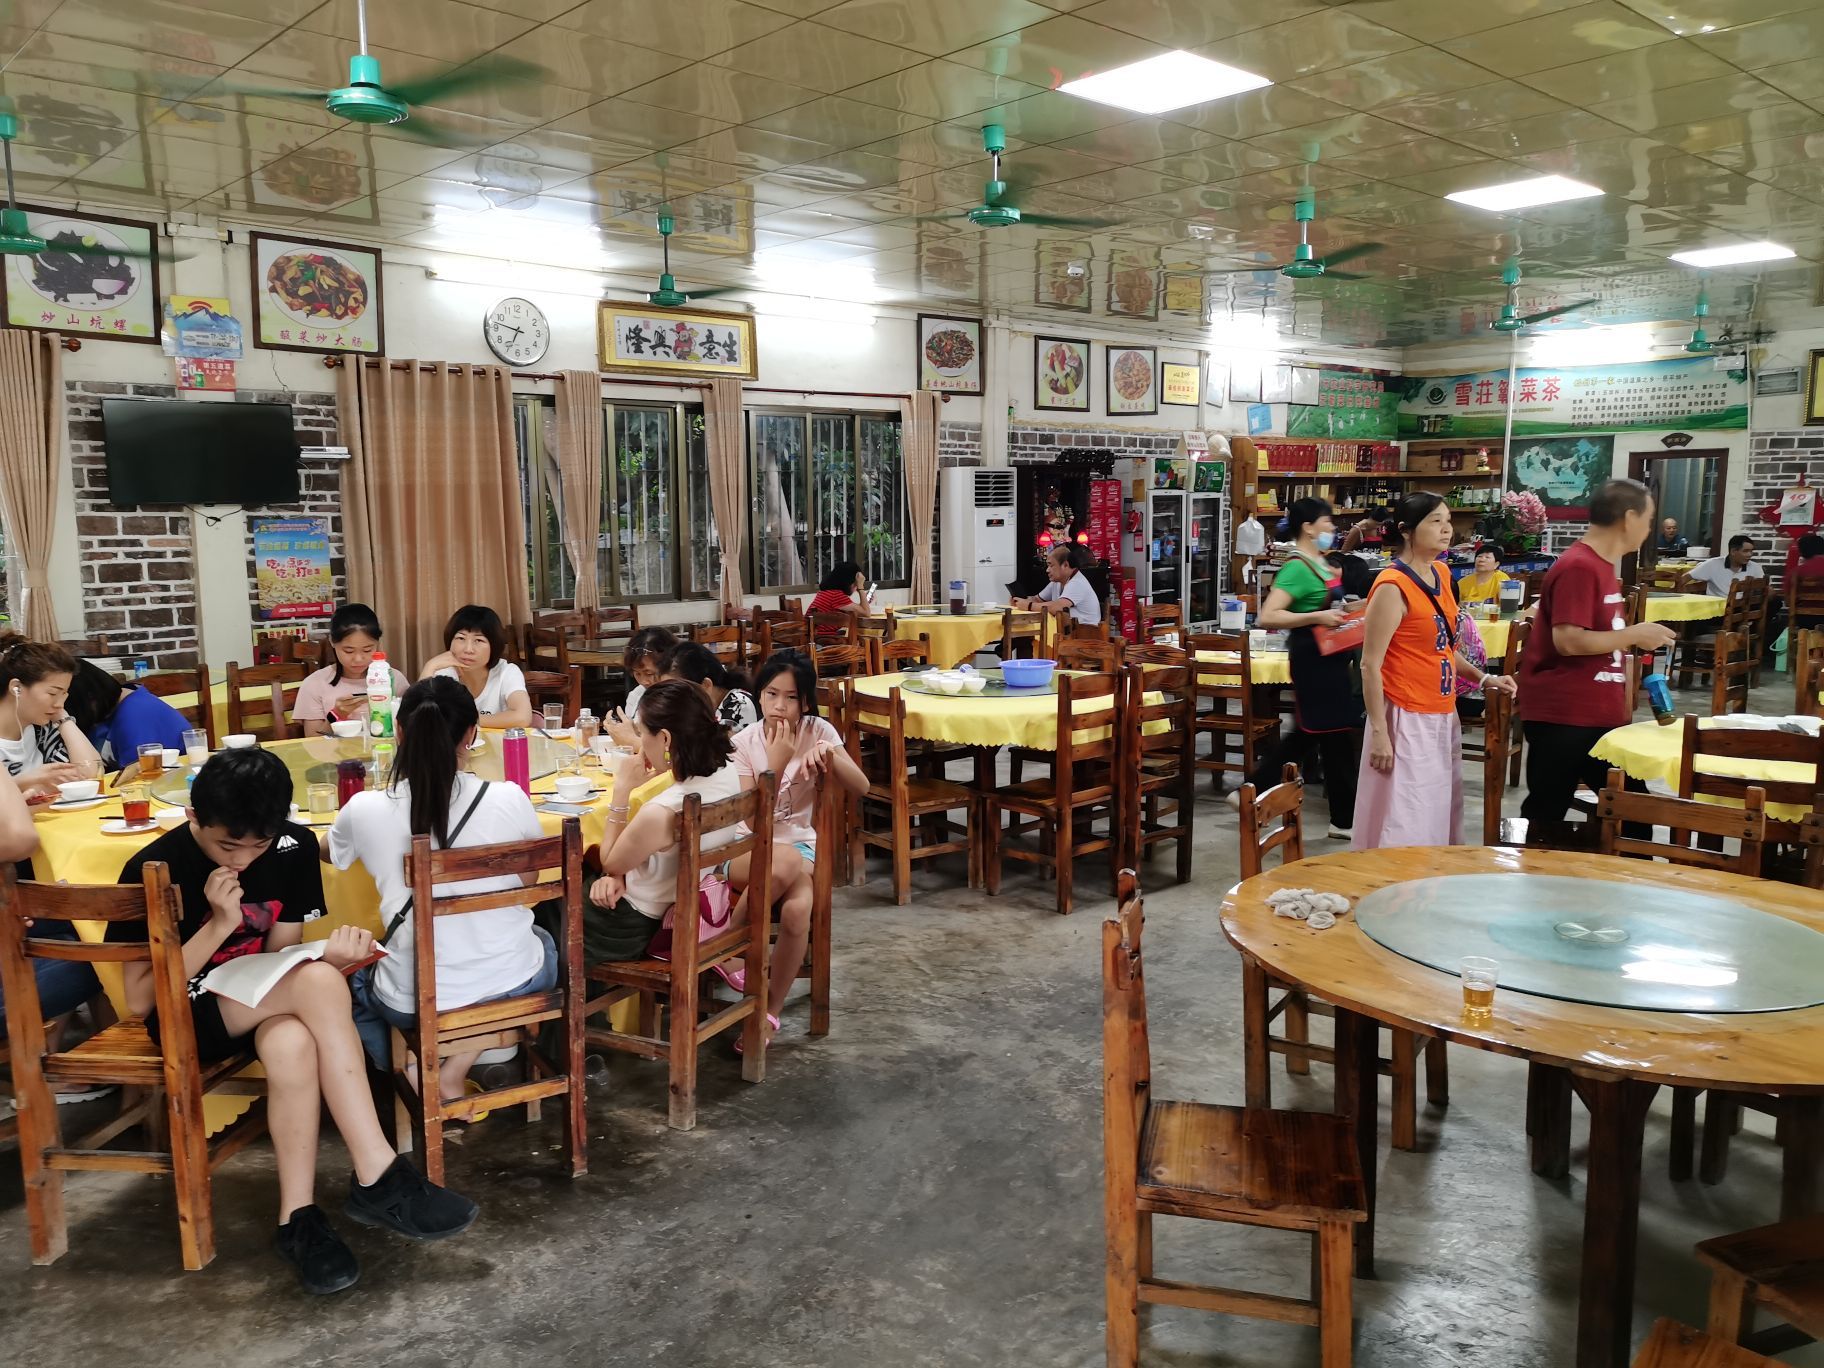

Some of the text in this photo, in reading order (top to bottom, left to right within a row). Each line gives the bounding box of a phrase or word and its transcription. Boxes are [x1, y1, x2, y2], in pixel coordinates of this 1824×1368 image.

[504, 306, 511, 315] 11
[513, 305, 521, 314] 12
[497, 313, 505, 322] 10
[532, 318, 537, 327] 2
[493, 324, 499, 332] 9
[536, 330, 541, 338] 3
[497, 335, 502, 344] 8
[515, 349, 521, 357] 6
[524, 348, 530, 356] 5
